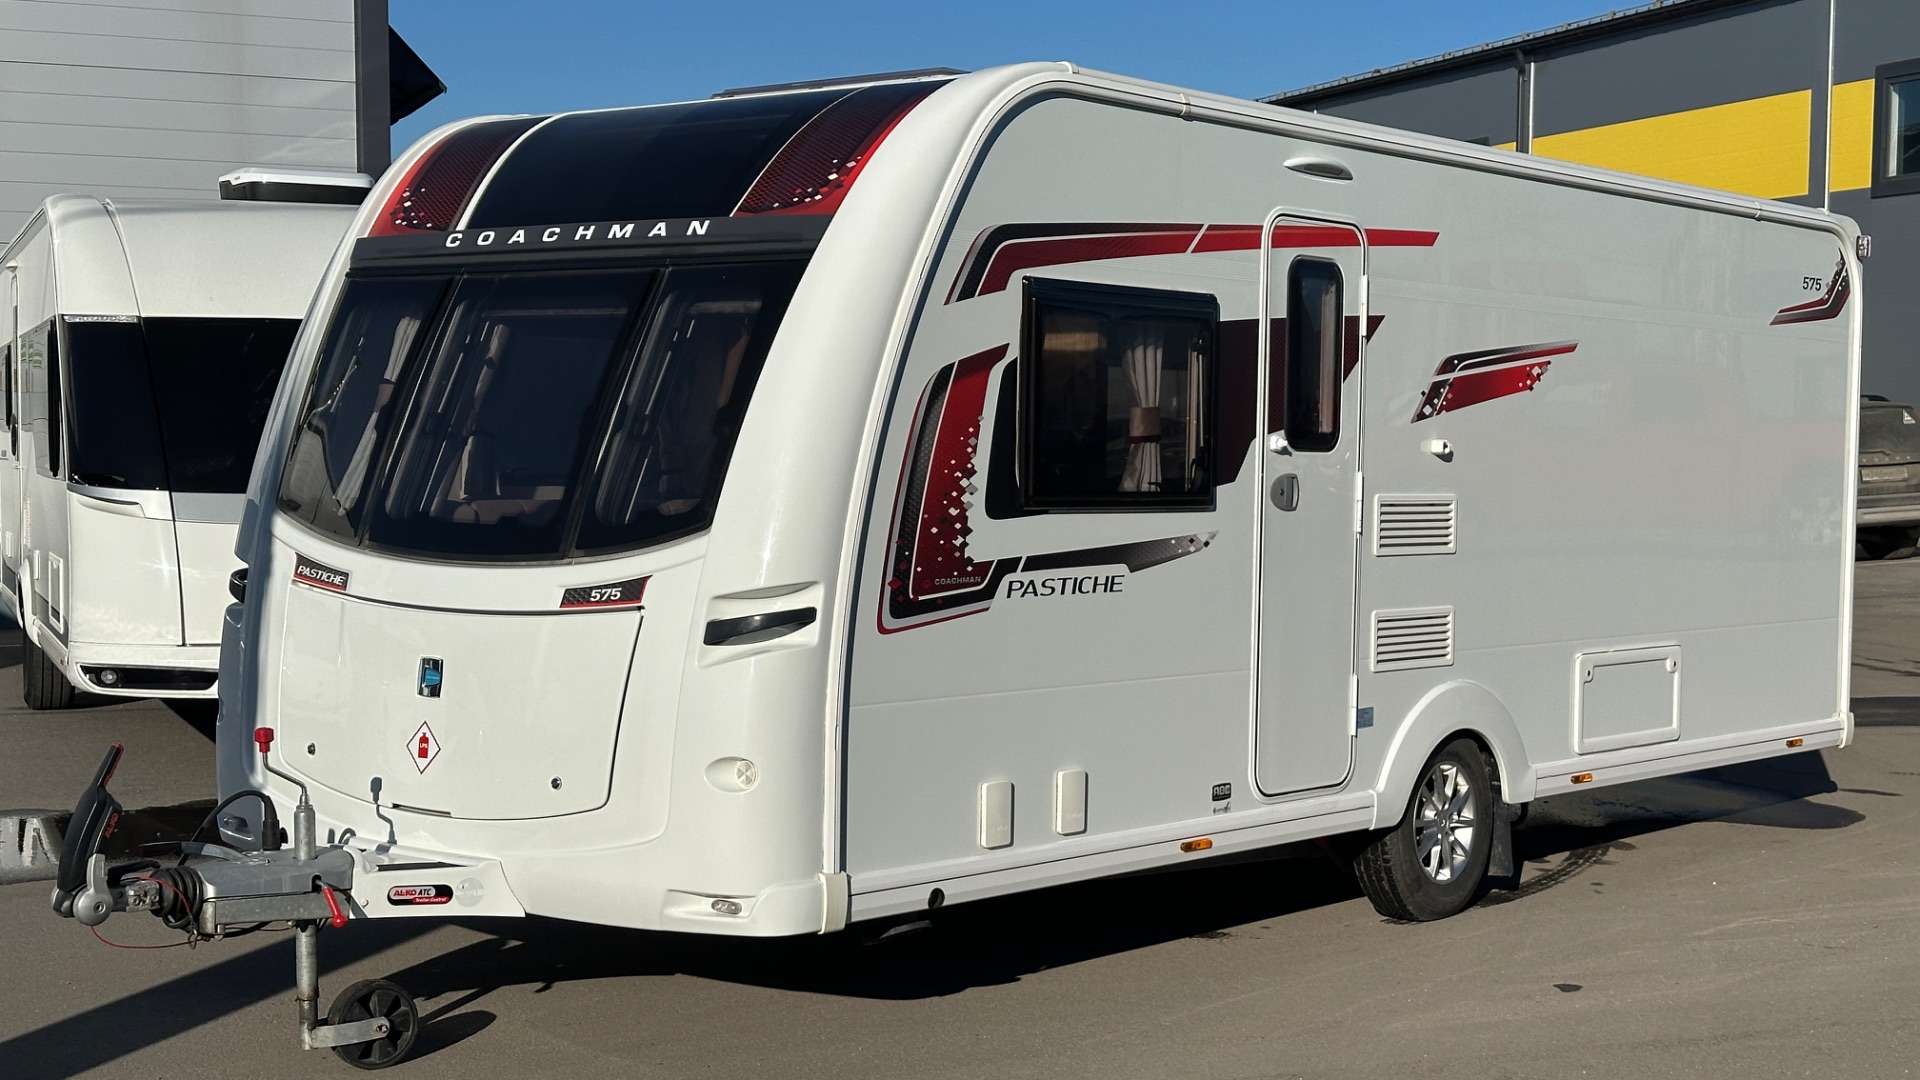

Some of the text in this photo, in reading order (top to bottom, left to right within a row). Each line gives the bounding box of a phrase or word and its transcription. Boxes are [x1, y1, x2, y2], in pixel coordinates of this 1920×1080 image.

[445, 220, 710, 248] COACHMAN
[1802, 276, 1822, 291] 575
[297, 565, 345, 586] PASTICHE
[934, 575, 982, 586] COACHMAN
[590, 587, 622, 601] 575
[1006, 574, 1126, 599] PASTICHE
[417, 888, 432, 896] ATC
